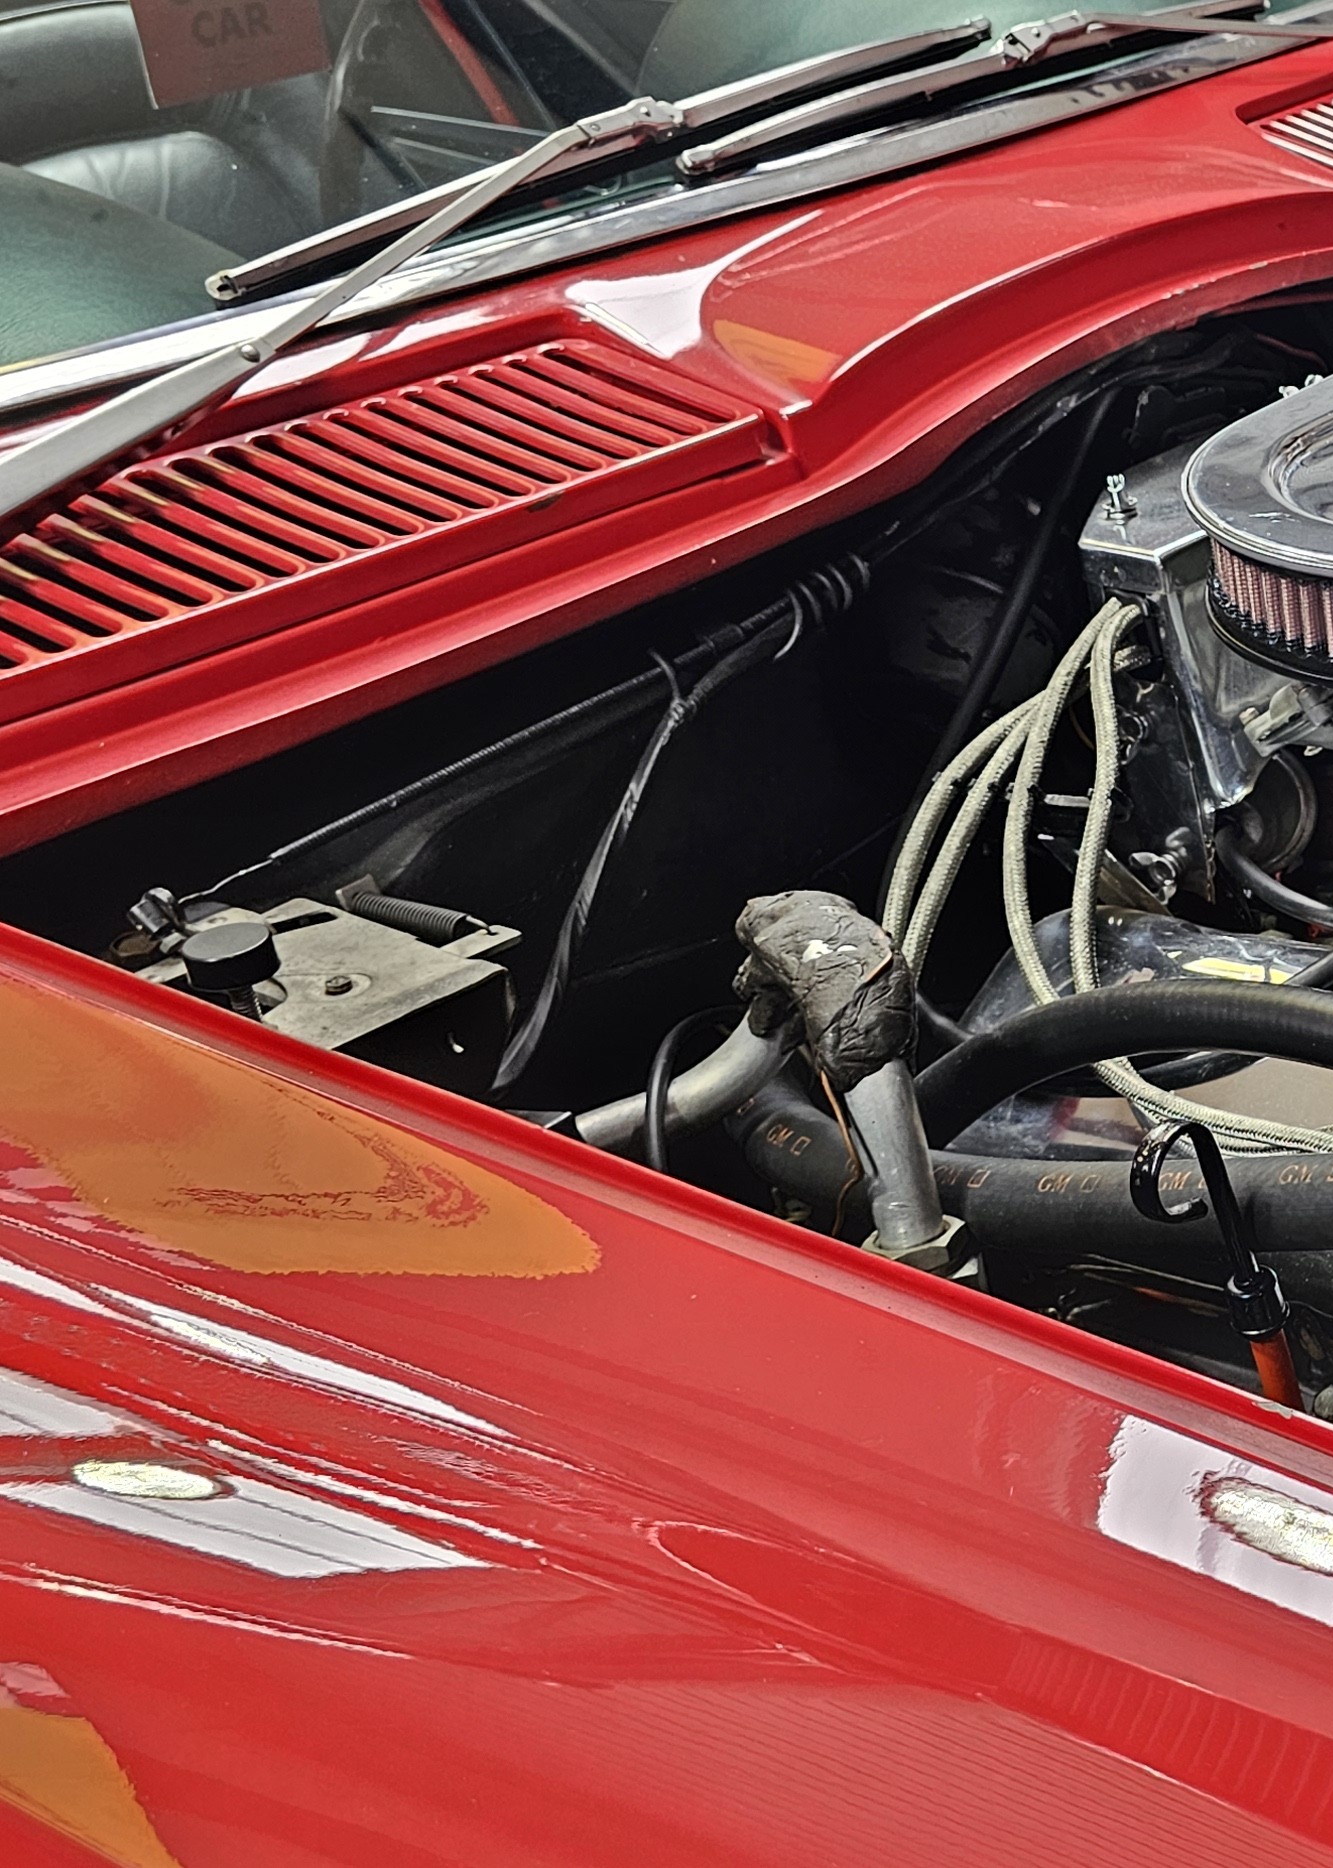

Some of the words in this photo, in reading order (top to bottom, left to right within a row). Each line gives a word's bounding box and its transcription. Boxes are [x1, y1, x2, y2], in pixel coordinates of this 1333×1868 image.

[192, 2, 274, 48] CAR
[766, 1123, 795, 1148] GM
[1037, 1174, 1073, 1193] GM
[1158, 1170, 1191, 1191] GM
[1279, 1163, 1319, 1185] GM
